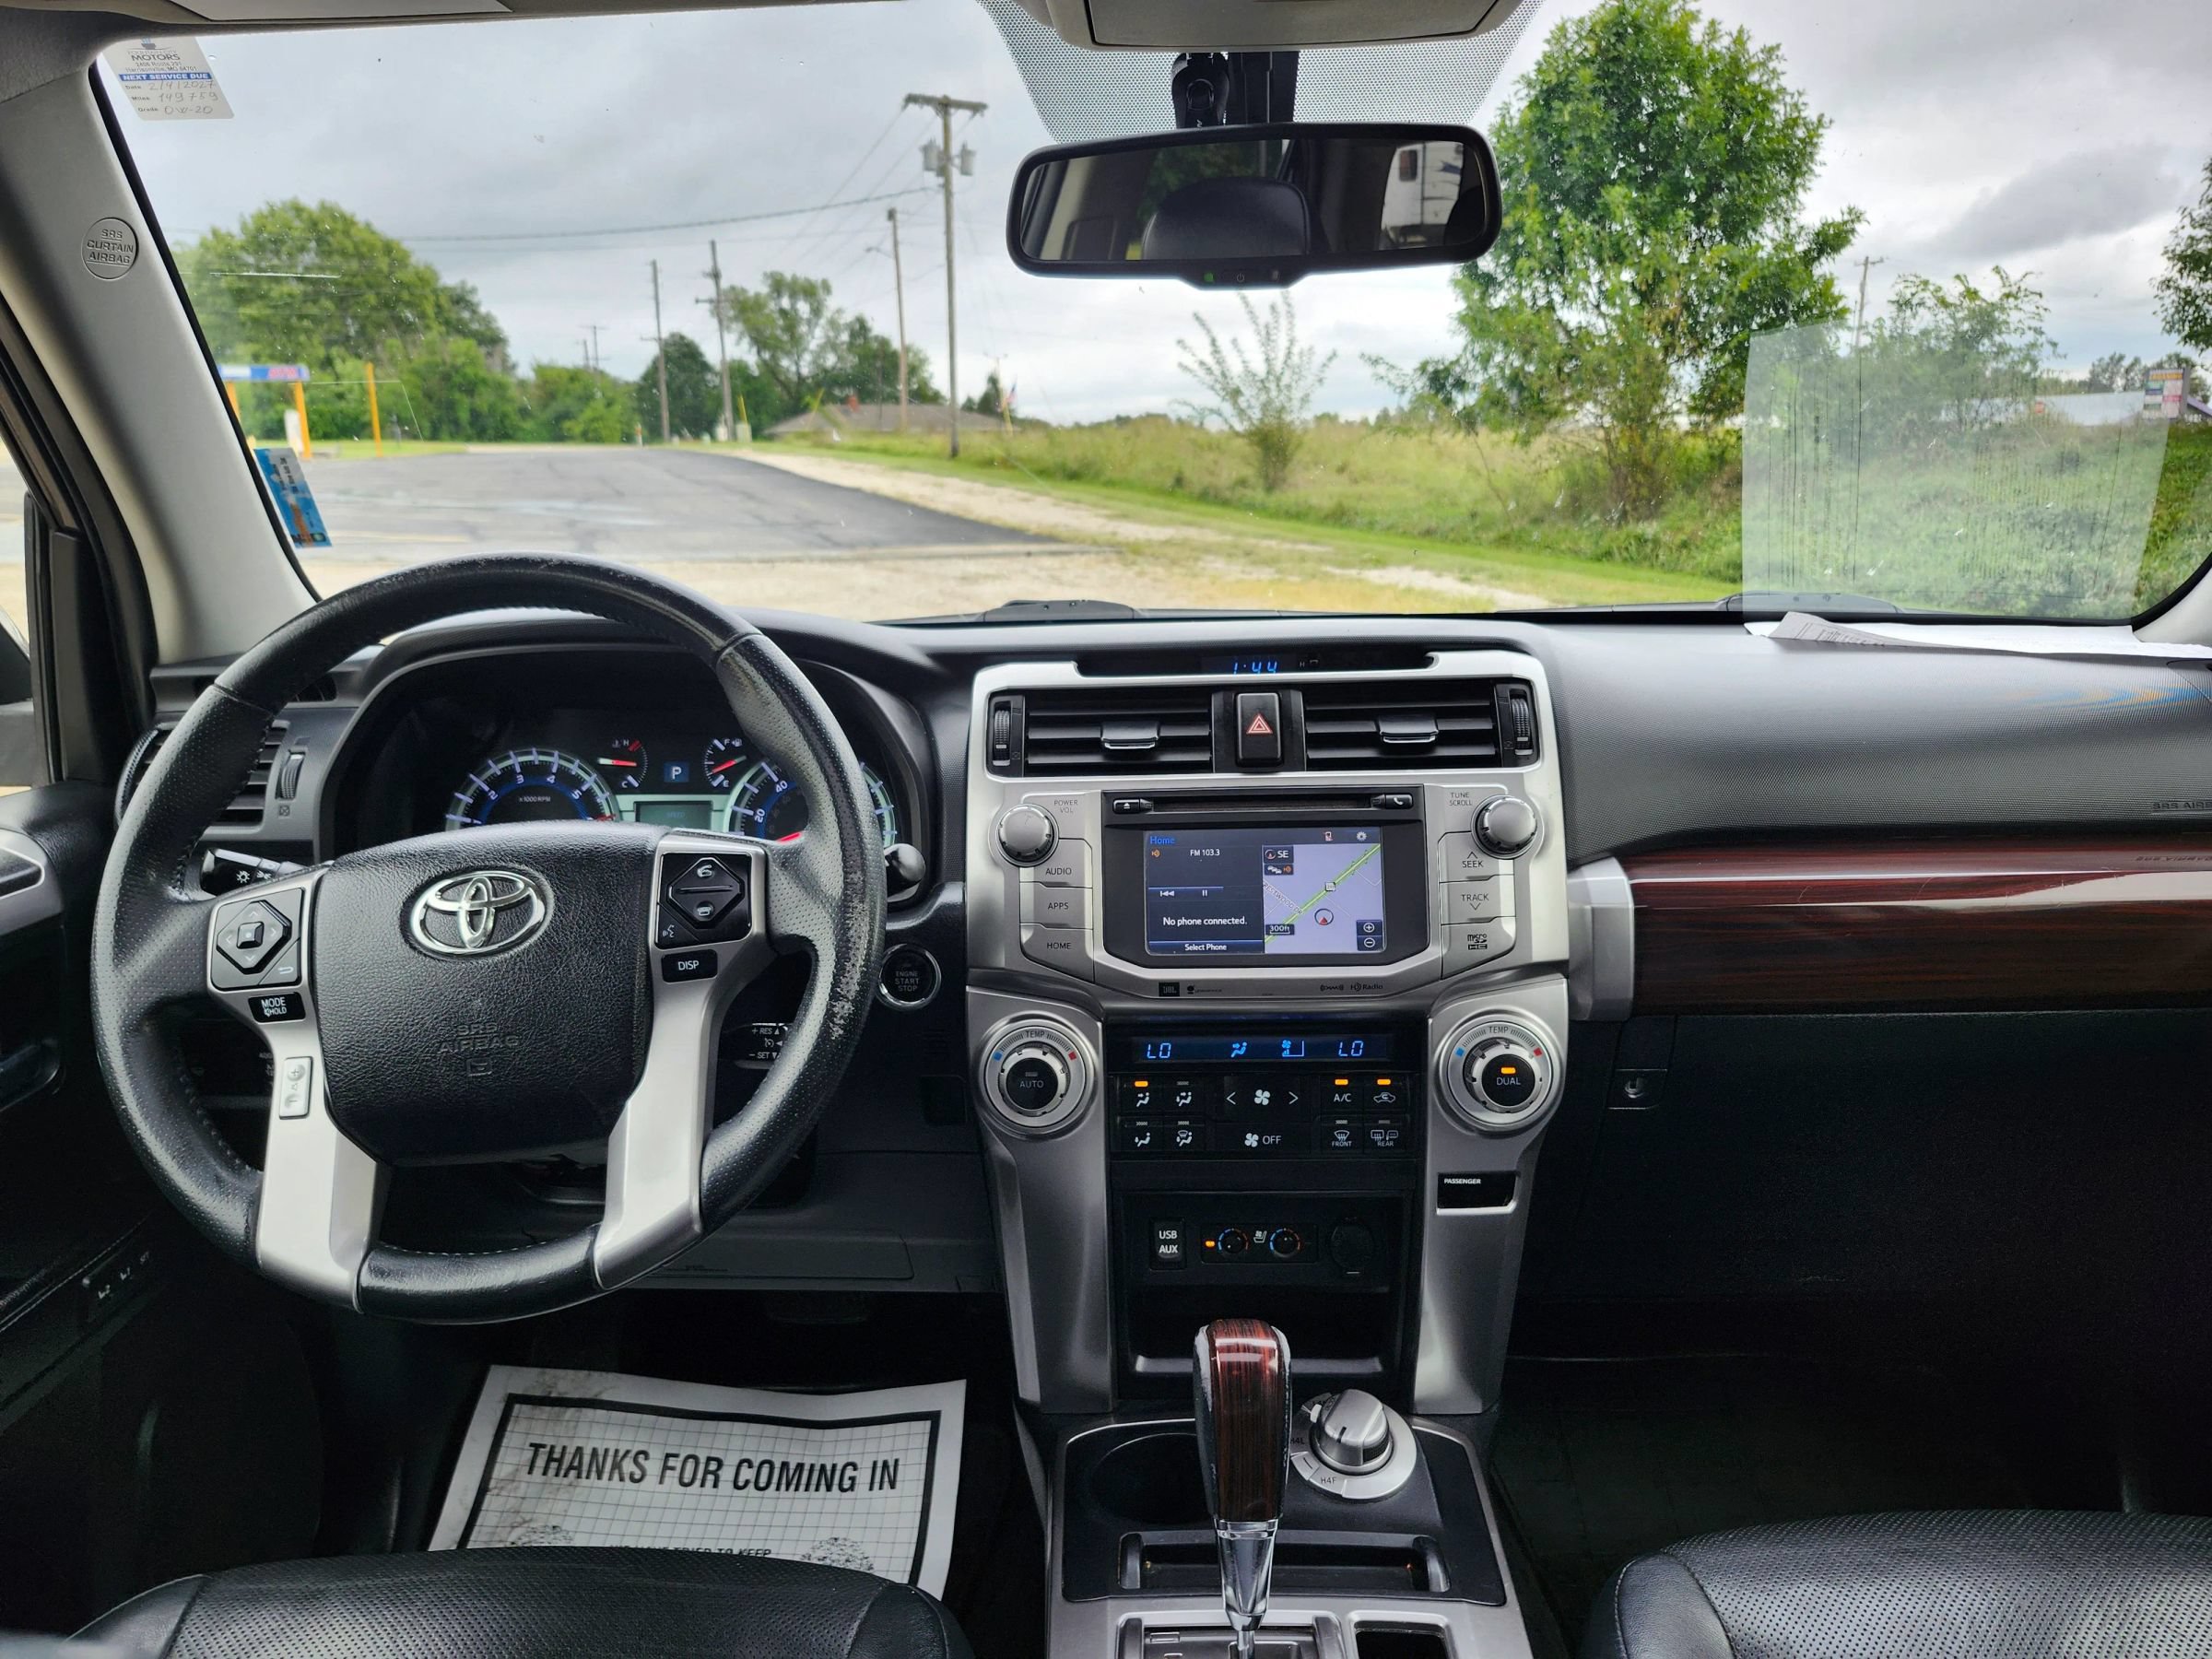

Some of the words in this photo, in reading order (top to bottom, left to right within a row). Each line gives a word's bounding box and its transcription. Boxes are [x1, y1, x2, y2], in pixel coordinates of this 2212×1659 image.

[101, 229, 124, 239] SRS
[87, 240, 134, 253] CURTAIN
[88, 251, 131, 265] AIRBAG
[671, 766, 682, 781] P
[515, 775, 524, 784] 3
[547, 775, 557, 784] 4
[775, 780, 788, 794] 40
[488, 790, 499, 801] 2
[571, 789, 582, 800] 5
[2152, 802, 2179, 810] SRS
[754, 808, 766, 823] 20
[1149, 835, 1175, 845] Home
[1190, 849, 1200, 857] FM
[1202, 848, 1220, 856] 103.3
[1277, 850, 1289, 859] SE
[1462, 860, 1484, 868] SEEK
[1045, 867, 1073, 876] AUDIO
[1462, 893, 1489, 901] TRACK
[1047, 901, 1069, 911] APPS
[1162, 916, 1176, 926] No
[1177, 916, 1202, 927] phone
[1203, 915, 1248, 926] connected.
[1269, 924, 1290, 933] 300ft
[1467, 933, 1488, 942] micro
[1046, 941, 1072, 950] HOME
[1184, 943, 1206, 951] Select
[1206, 943, 1228, 951] Phone
[677, 959, 700, 971] DISP
[898, 984, 918, 993] STOP
[261, 996, 287, 1008] MODE
[269, 1006, 288, 1015] HOLD
[1025, 1030, 1045, 1039] TEMP
[1019, 1079, 1044, 1088] AUTO
[1496, 1077, 1522, 1086] DUAL
[1333, 1093, 1352, 1103] A/C
[1262, 1135, 1282, 1145] OFF
[1159, 1230, 1178, 1240] USB
[1159, 1244, 1179, 1254] AUX
[527, 1442, 651, 1485] THANKS
[658, 1452, 724, 1489] FOR
[733, 1457, 859, 1494] COMING
[868, 1457, 900, 1492] IN
[1321, 1476, 1337, 1485] H4F
